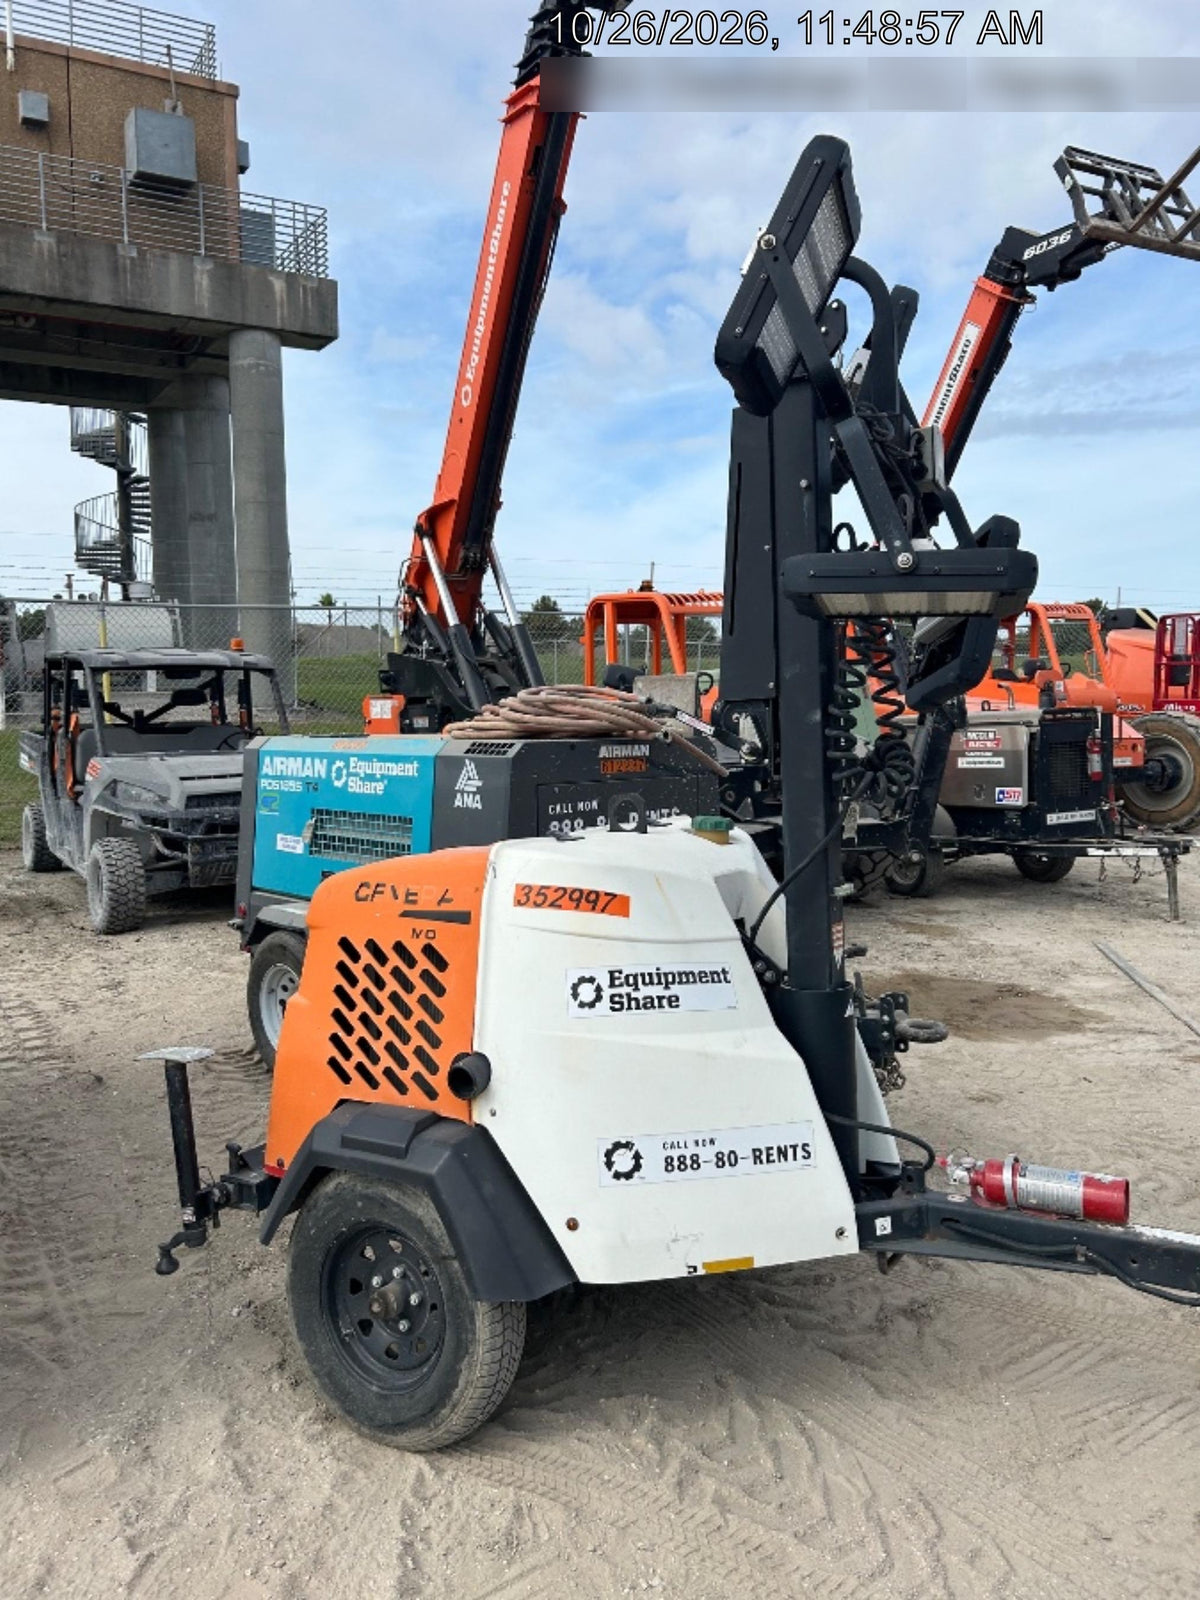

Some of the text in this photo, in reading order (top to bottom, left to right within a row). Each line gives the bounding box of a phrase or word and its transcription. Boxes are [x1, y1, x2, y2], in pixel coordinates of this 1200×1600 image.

[1022, 229, 1073, 260] 6036
[465, 180, 512, 386] EquipmentShare
[599, 744, 650, 758] AIRMAN
[262, 755, 328, 779] AIRMAN
[349, 757, 420, 778] Equipment
[348, 777, 386, 795] Share
[548, 802, 574, 815] CALL
[517, 884, 618, 913] 352997
[608, 966, 732, 992] Equipment
[609, 992, 680, 1013] Share
[662, 1137, 717, 1150] CALL NOW
[664, 1142, 812, 1173] 888-80-RENTS
